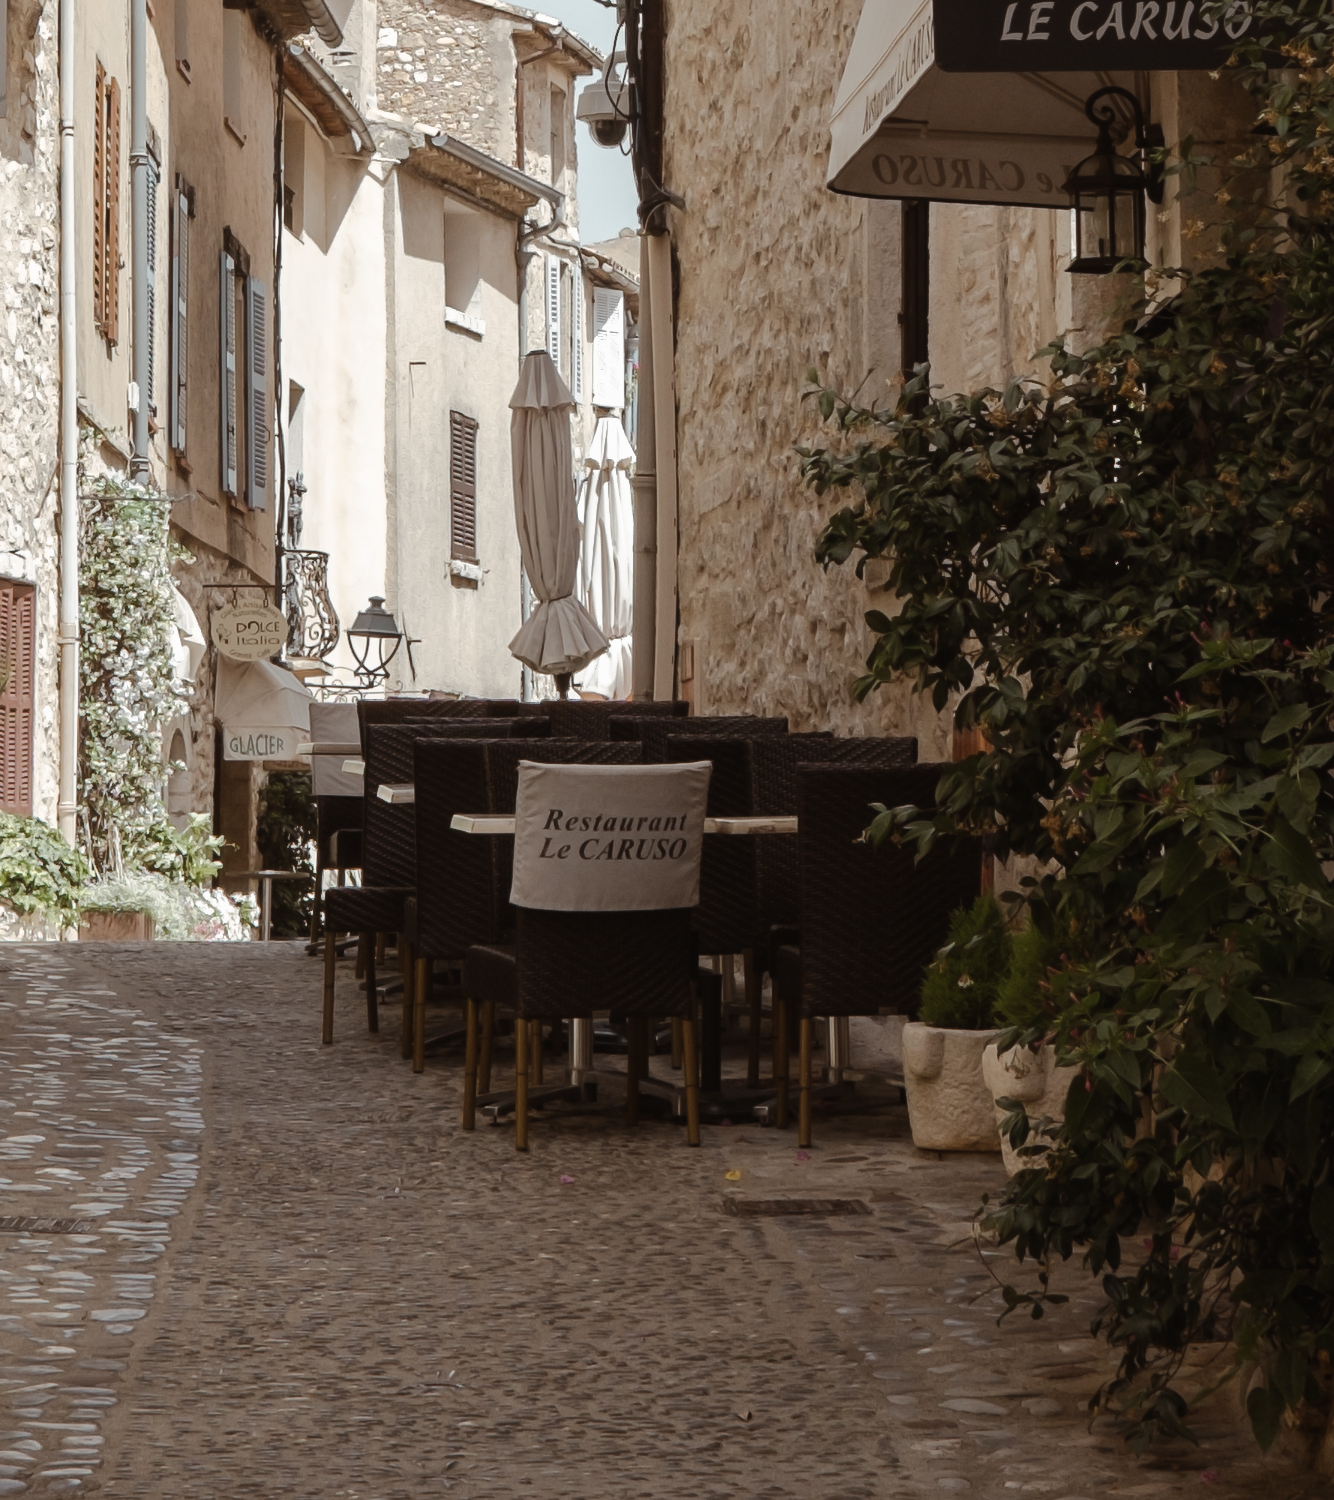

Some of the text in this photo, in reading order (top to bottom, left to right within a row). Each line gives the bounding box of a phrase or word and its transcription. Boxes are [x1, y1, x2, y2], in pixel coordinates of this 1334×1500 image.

[999, 0, 1253, 42] LE CARUSO
[236, 620, 280, 635] DOLCE
[236, 635, 280, 645] Italia
[229, 733, 285, 756] GLACIER
[543, 807, 688, 833] Restaurant
[538, 836, 688, 861] Le CARUSO
